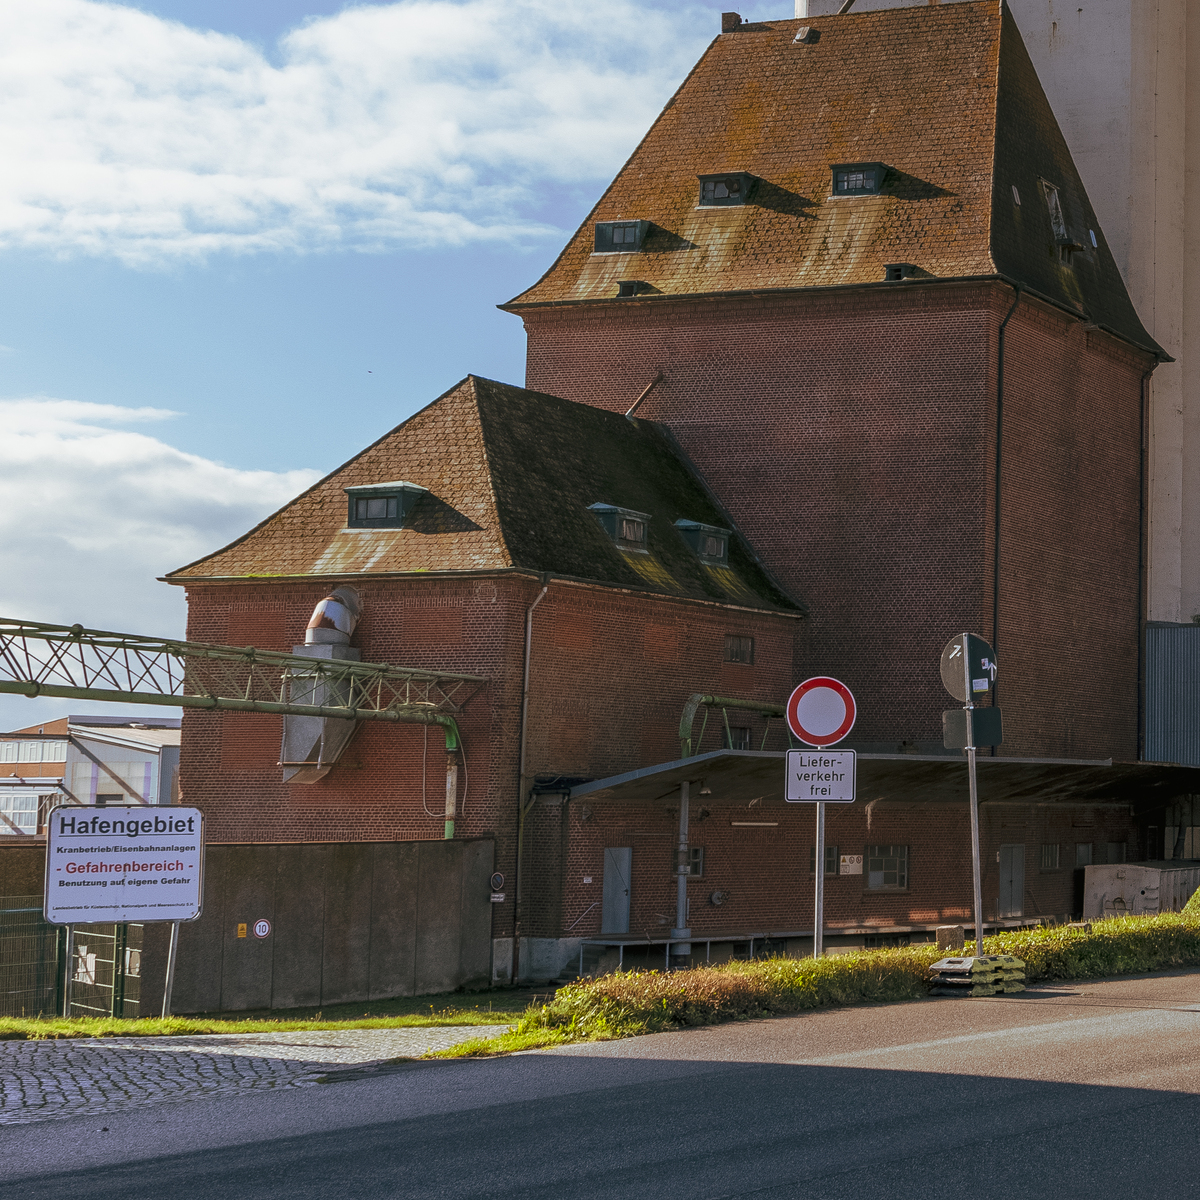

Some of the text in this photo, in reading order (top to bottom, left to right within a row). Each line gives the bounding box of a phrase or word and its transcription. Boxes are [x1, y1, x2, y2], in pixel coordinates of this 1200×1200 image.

[800, 756, 842, 767] Liefer-
[796, 770, 845, 782] verkehr
[810, 784, 831, 796] frei
[60, 816, 195, 837] Hafengebiet
[56, 845, 196, 854] Kranbetrieb/Eisenbahnanlagen
[65, 860, 184, 874] Gefahrenbereich
[160, 877, 191, 885] Gefahr
[258, 924, 267, 933] 10
